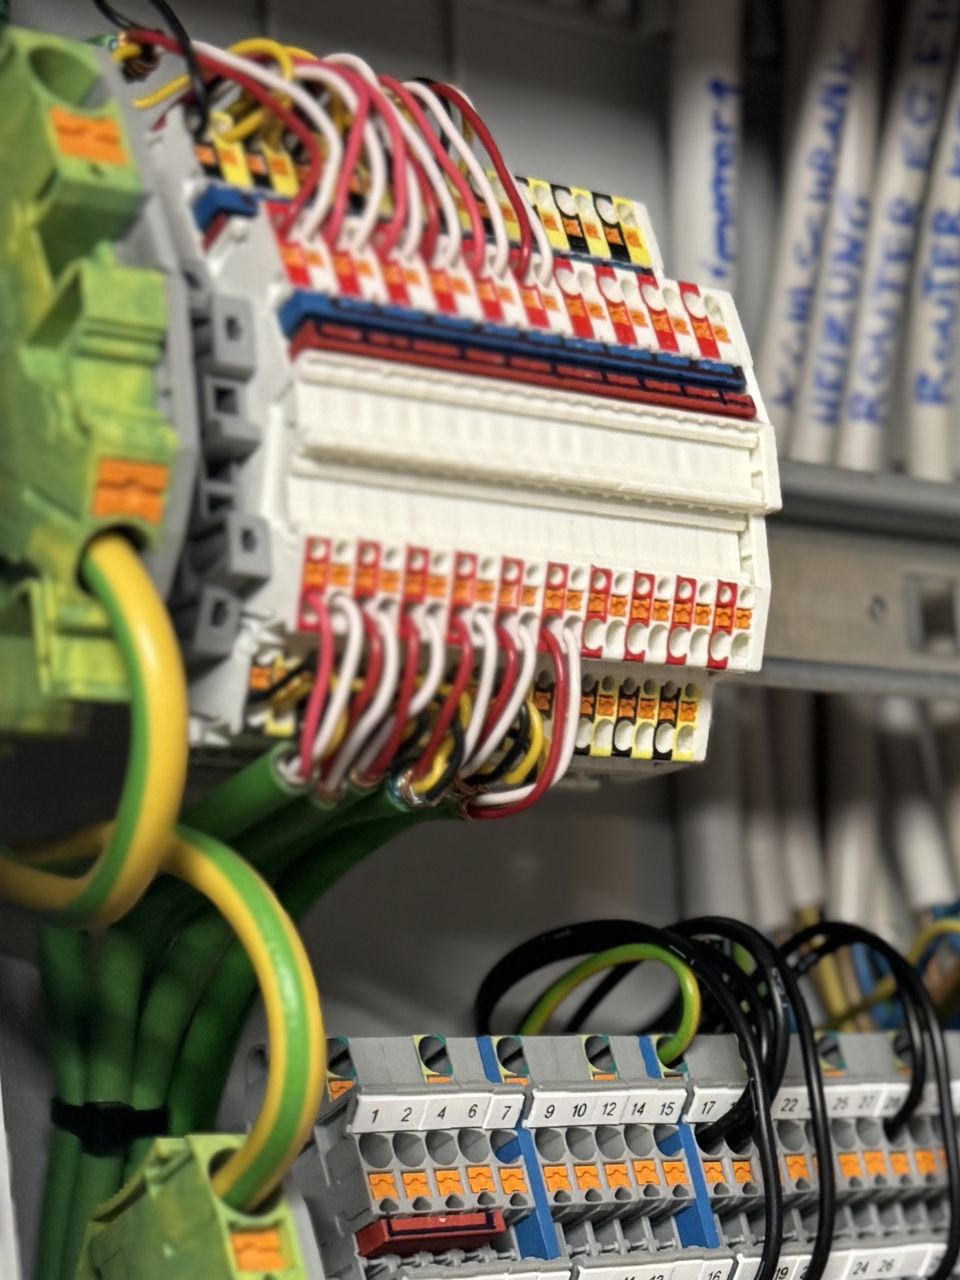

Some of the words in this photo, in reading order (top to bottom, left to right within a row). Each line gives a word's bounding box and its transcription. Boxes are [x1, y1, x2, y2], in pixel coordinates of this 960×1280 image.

[371, 1109, 380, 1123] 1
[401, 1107, 413, 1122] 2
[437, 1106, 447, 1120] 4
[468, 1104, 478, 1119] 6
[502, 1106, 512, 1120] 7
[544, 1104, 555, 1119] 9
[572, 1103, 587, 1117] 10
[602, 1102, 617, 1116] 12
[631, 1102, 646, 1116] 14
[660, 1102, 675, 1116] 15
[701, 1101, 716, 1115] 17
[780, 1098, 799, 1112] 22
[832, 1096, 849, 1110] 25
[774, 1266, 789, 1280] 19
[853, 1262, 869, 1275] 24
[878, 1259, 894, 1272] 26
